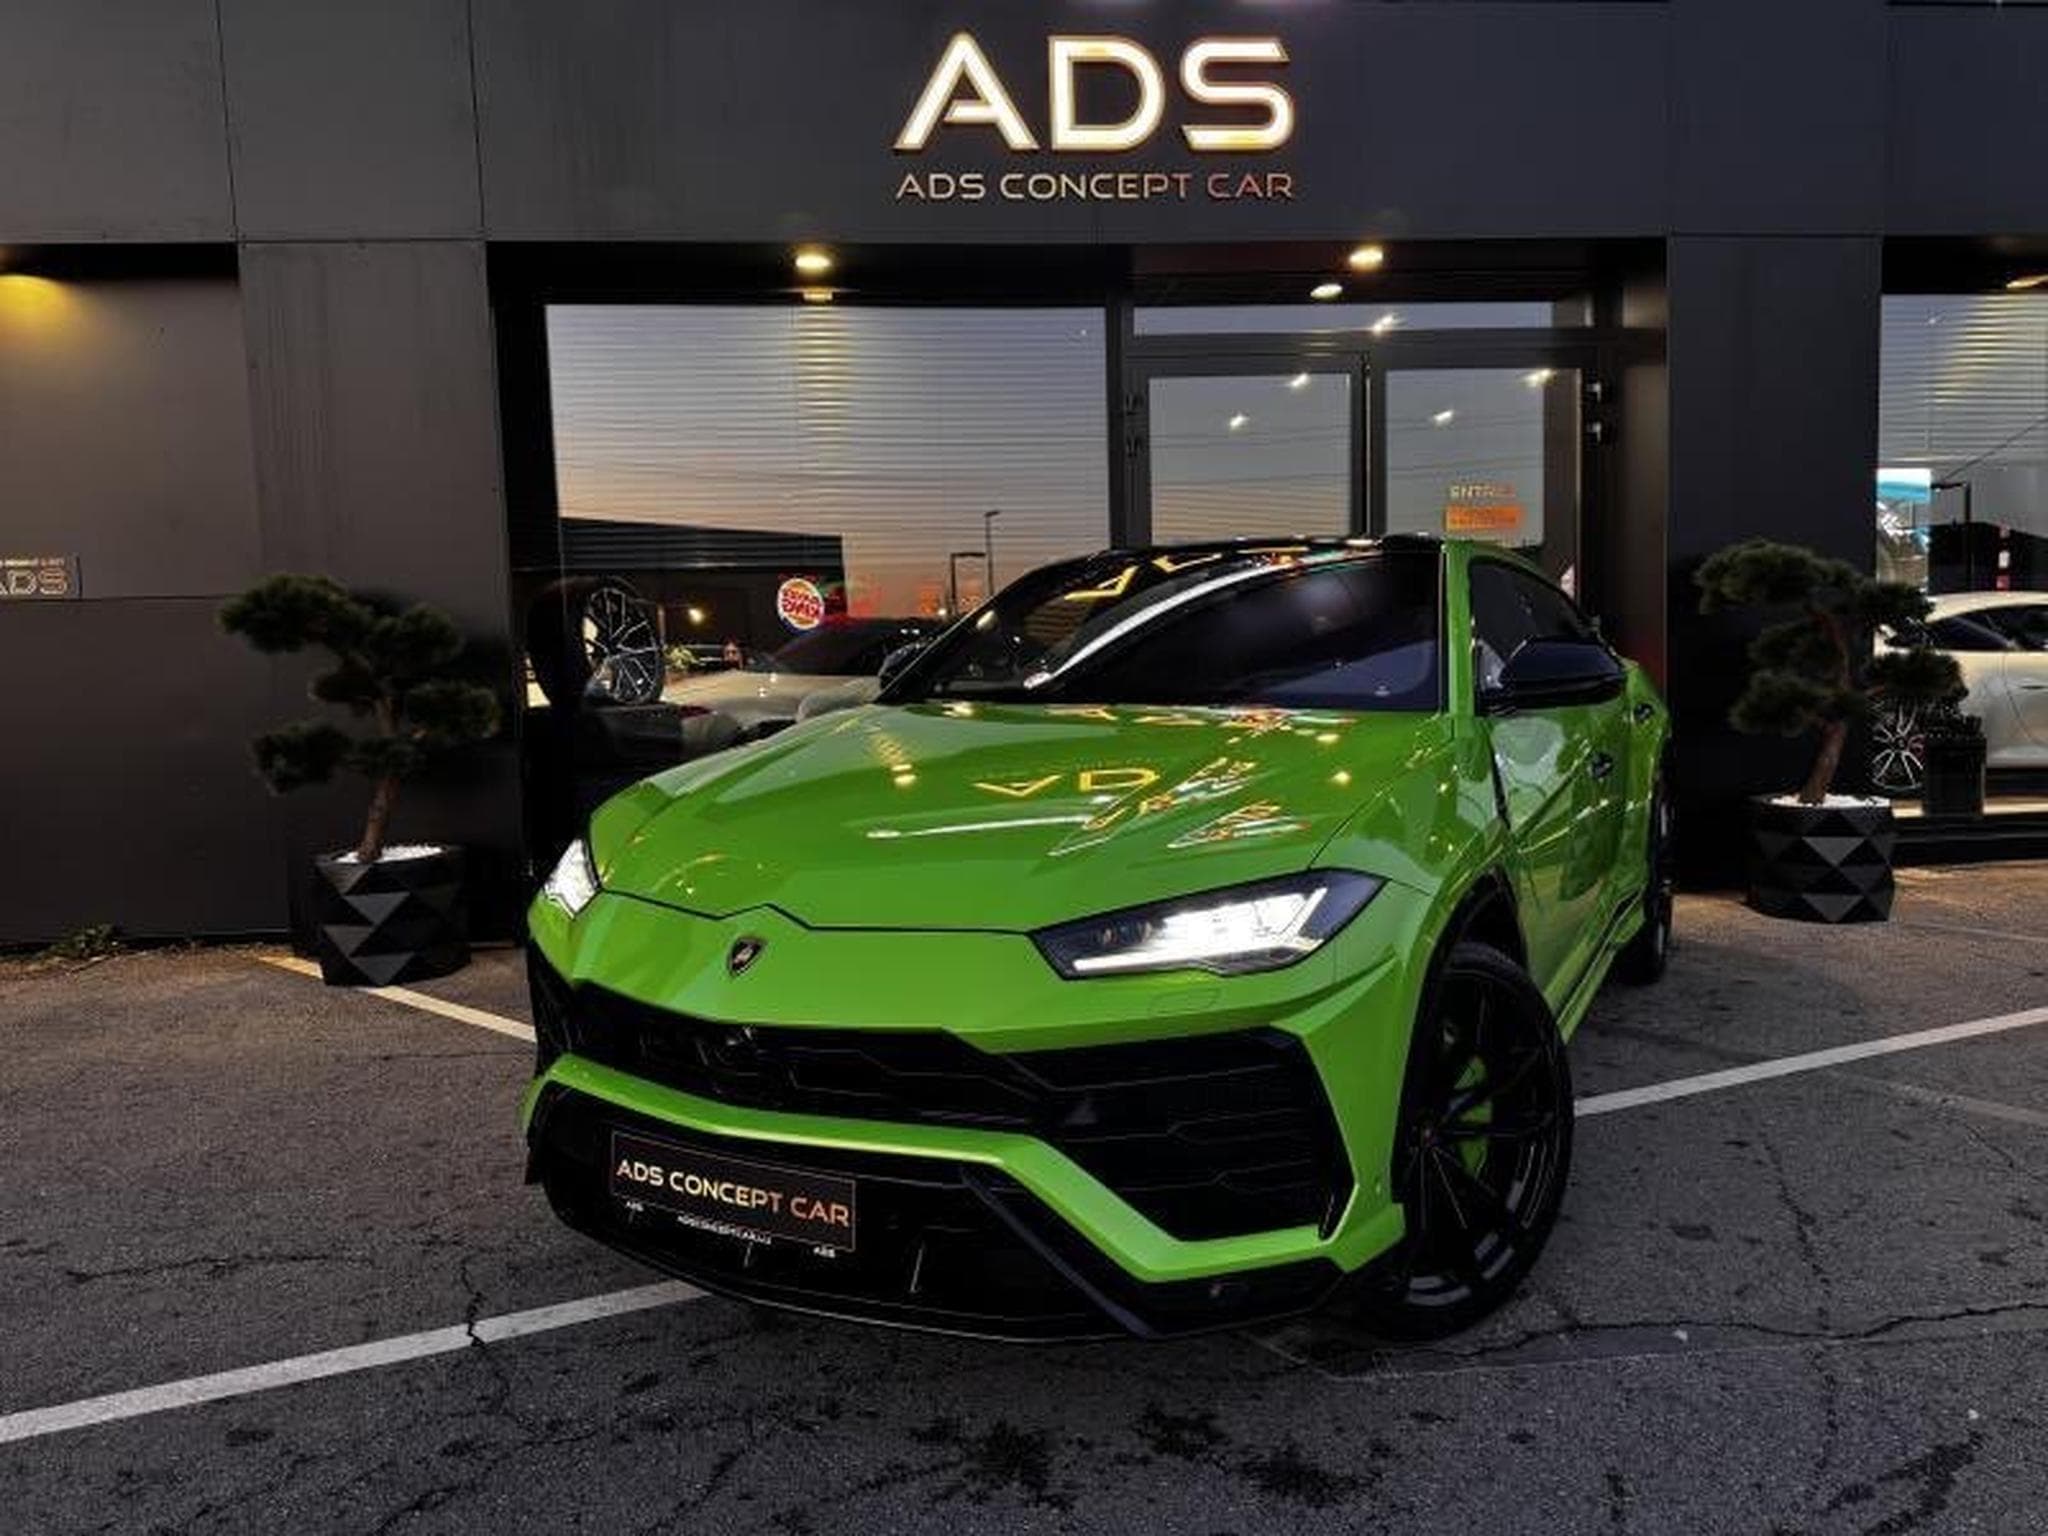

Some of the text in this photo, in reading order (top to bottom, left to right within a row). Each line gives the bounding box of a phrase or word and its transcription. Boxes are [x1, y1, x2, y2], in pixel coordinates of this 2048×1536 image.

[894, 30, 1295, 151] ADS
[896, 173, 1292, 200] ADS CONCEPT CAR
[0, 569, 68, 596] DS
[616, 1159, 850, 1227] ADS CONCEPT CAR
